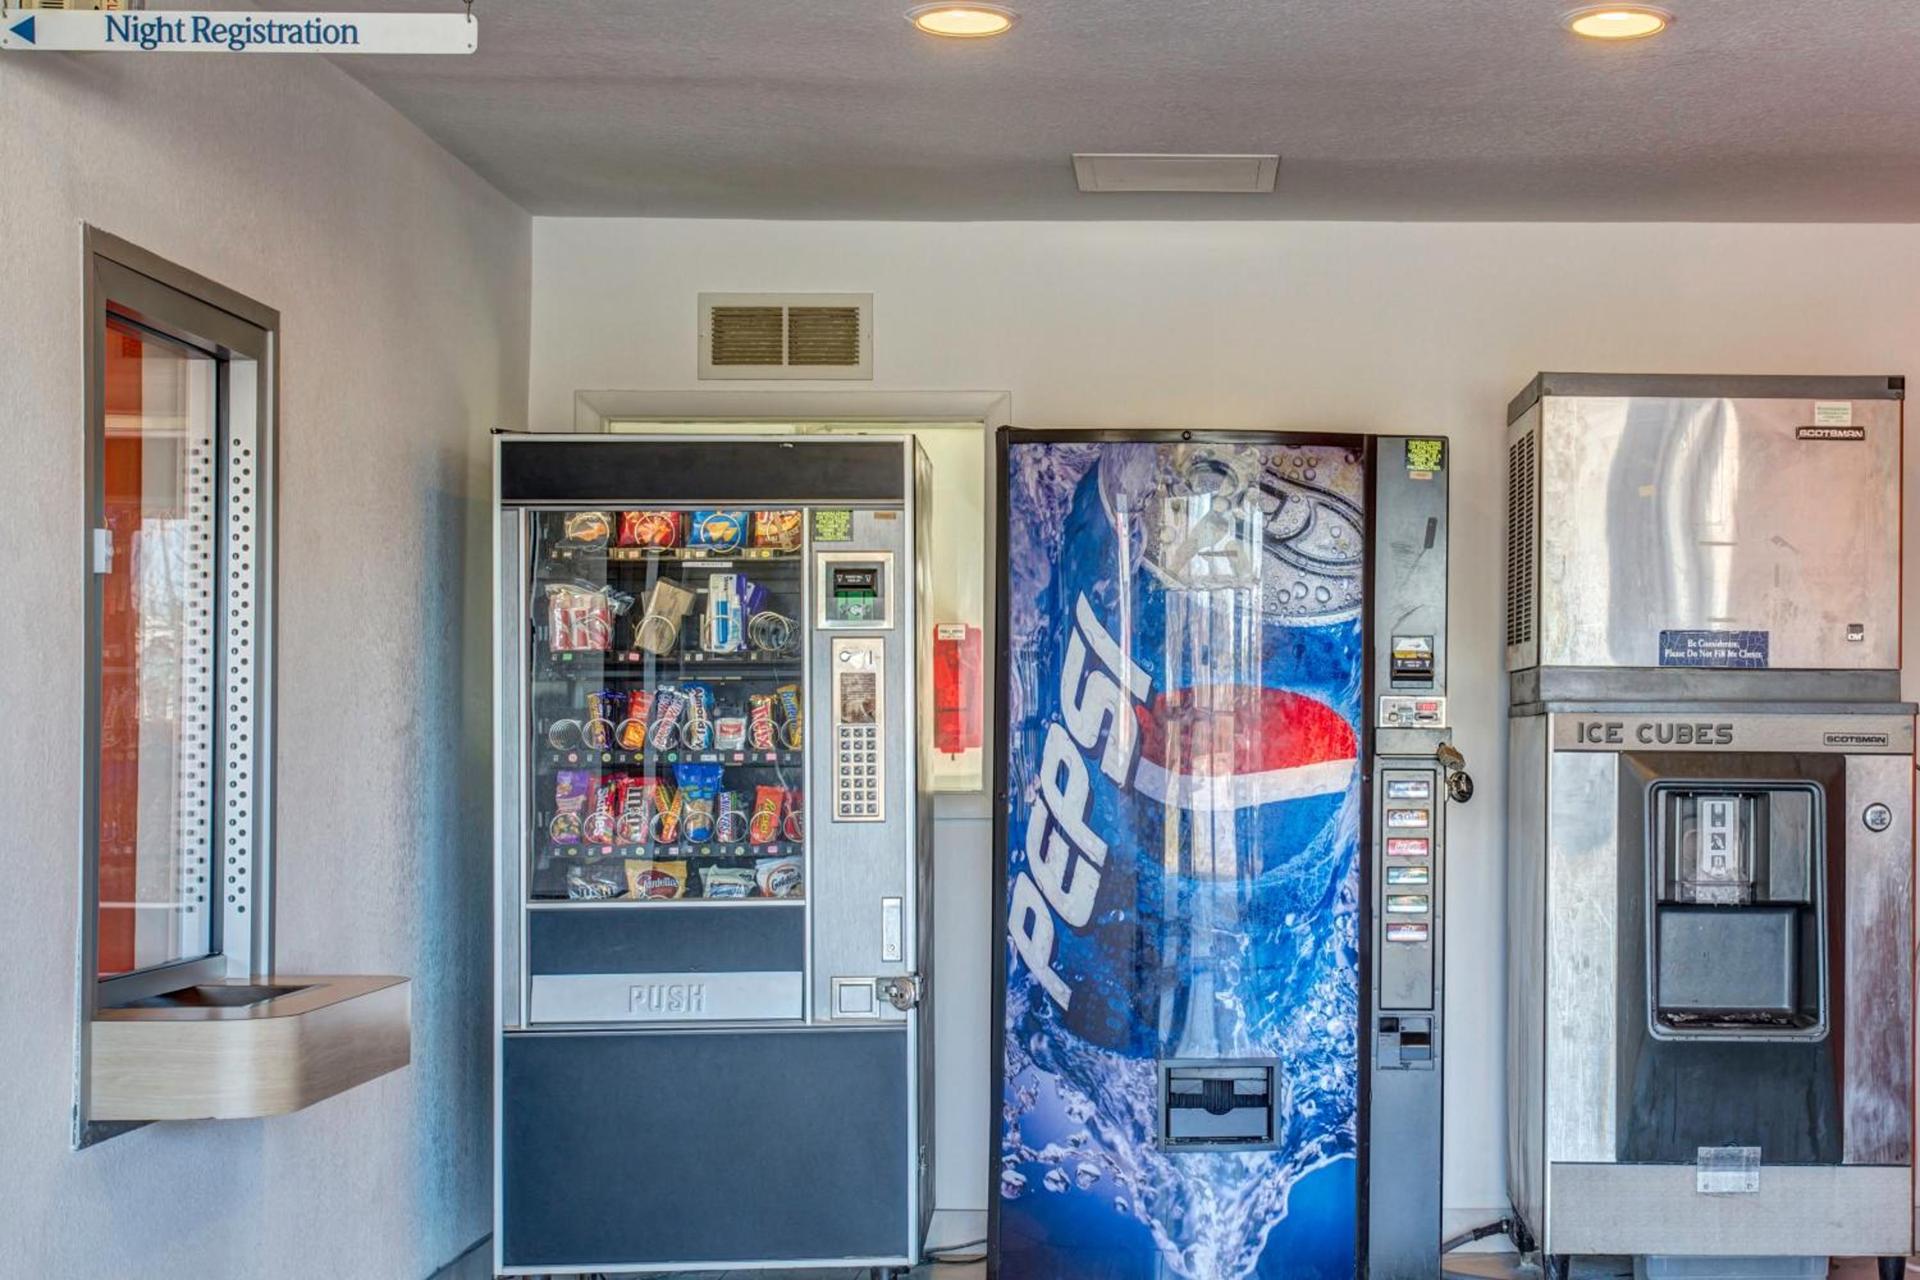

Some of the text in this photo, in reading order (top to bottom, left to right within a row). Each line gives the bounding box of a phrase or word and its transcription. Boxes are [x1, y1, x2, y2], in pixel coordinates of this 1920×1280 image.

[105, 15, 360, 51] Night Registration
[1799, 429, 1863, 438] SCOTSMAN
[1664, 648, 1685, 658] Please
[1687, 648, 1698, 658] Do
[1700, 648, 1712, 658] Not
[1687, 639, 1697, 647] Be
[694, 687, 706, 729] Almond
[751, 702, 772, 748] Twix
[1577, 722, 1734, 745] ICE CUBES
[1826, 735, 1887, 744] SCOTSMAN
[594, 787, 608, 836] Skittles
[1008, 590, 1154, 1012] PEPSI
[628, 983, 706, 1014] PUSH
